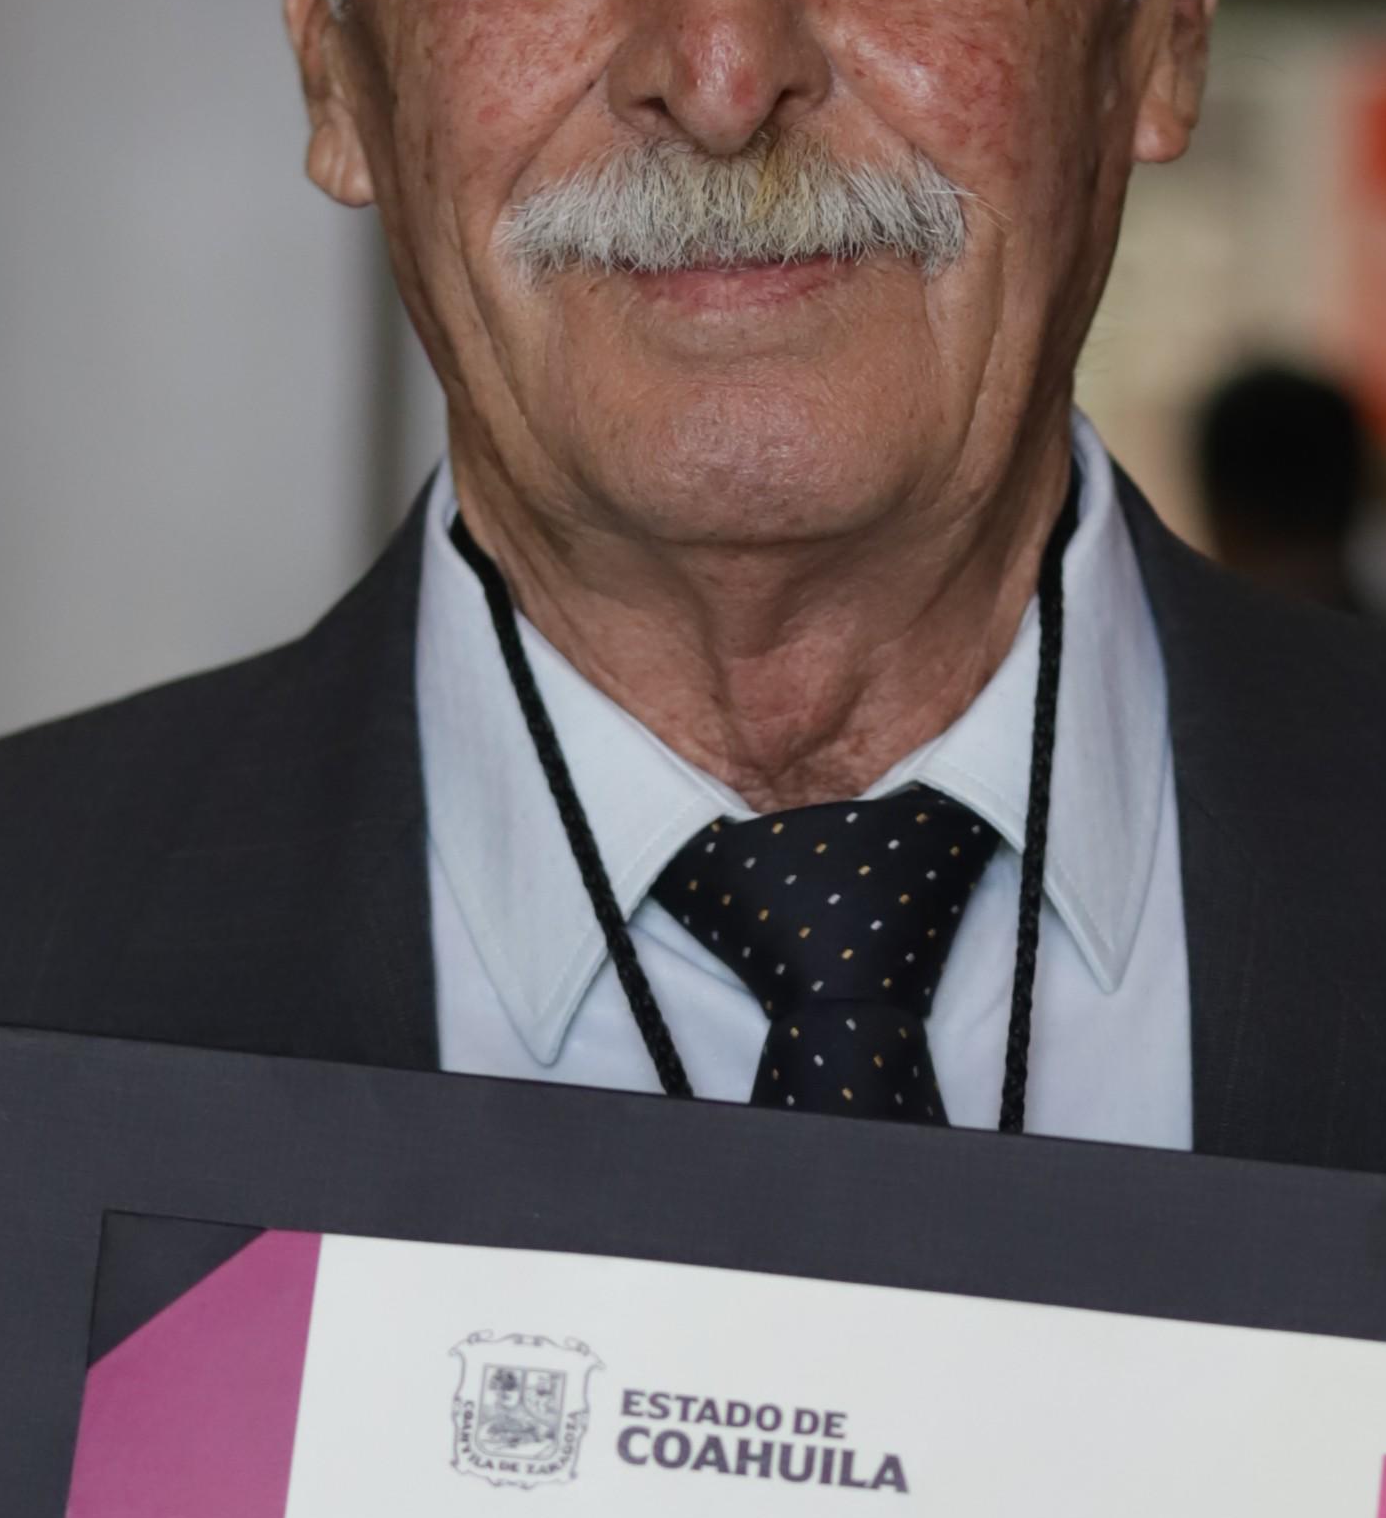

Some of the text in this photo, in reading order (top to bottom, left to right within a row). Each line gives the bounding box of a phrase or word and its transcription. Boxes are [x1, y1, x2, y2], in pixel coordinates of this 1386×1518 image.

[621, 1389, 847, 1440] ESTADO DE
[616, 1425, 909, 1494] COAHUILA
